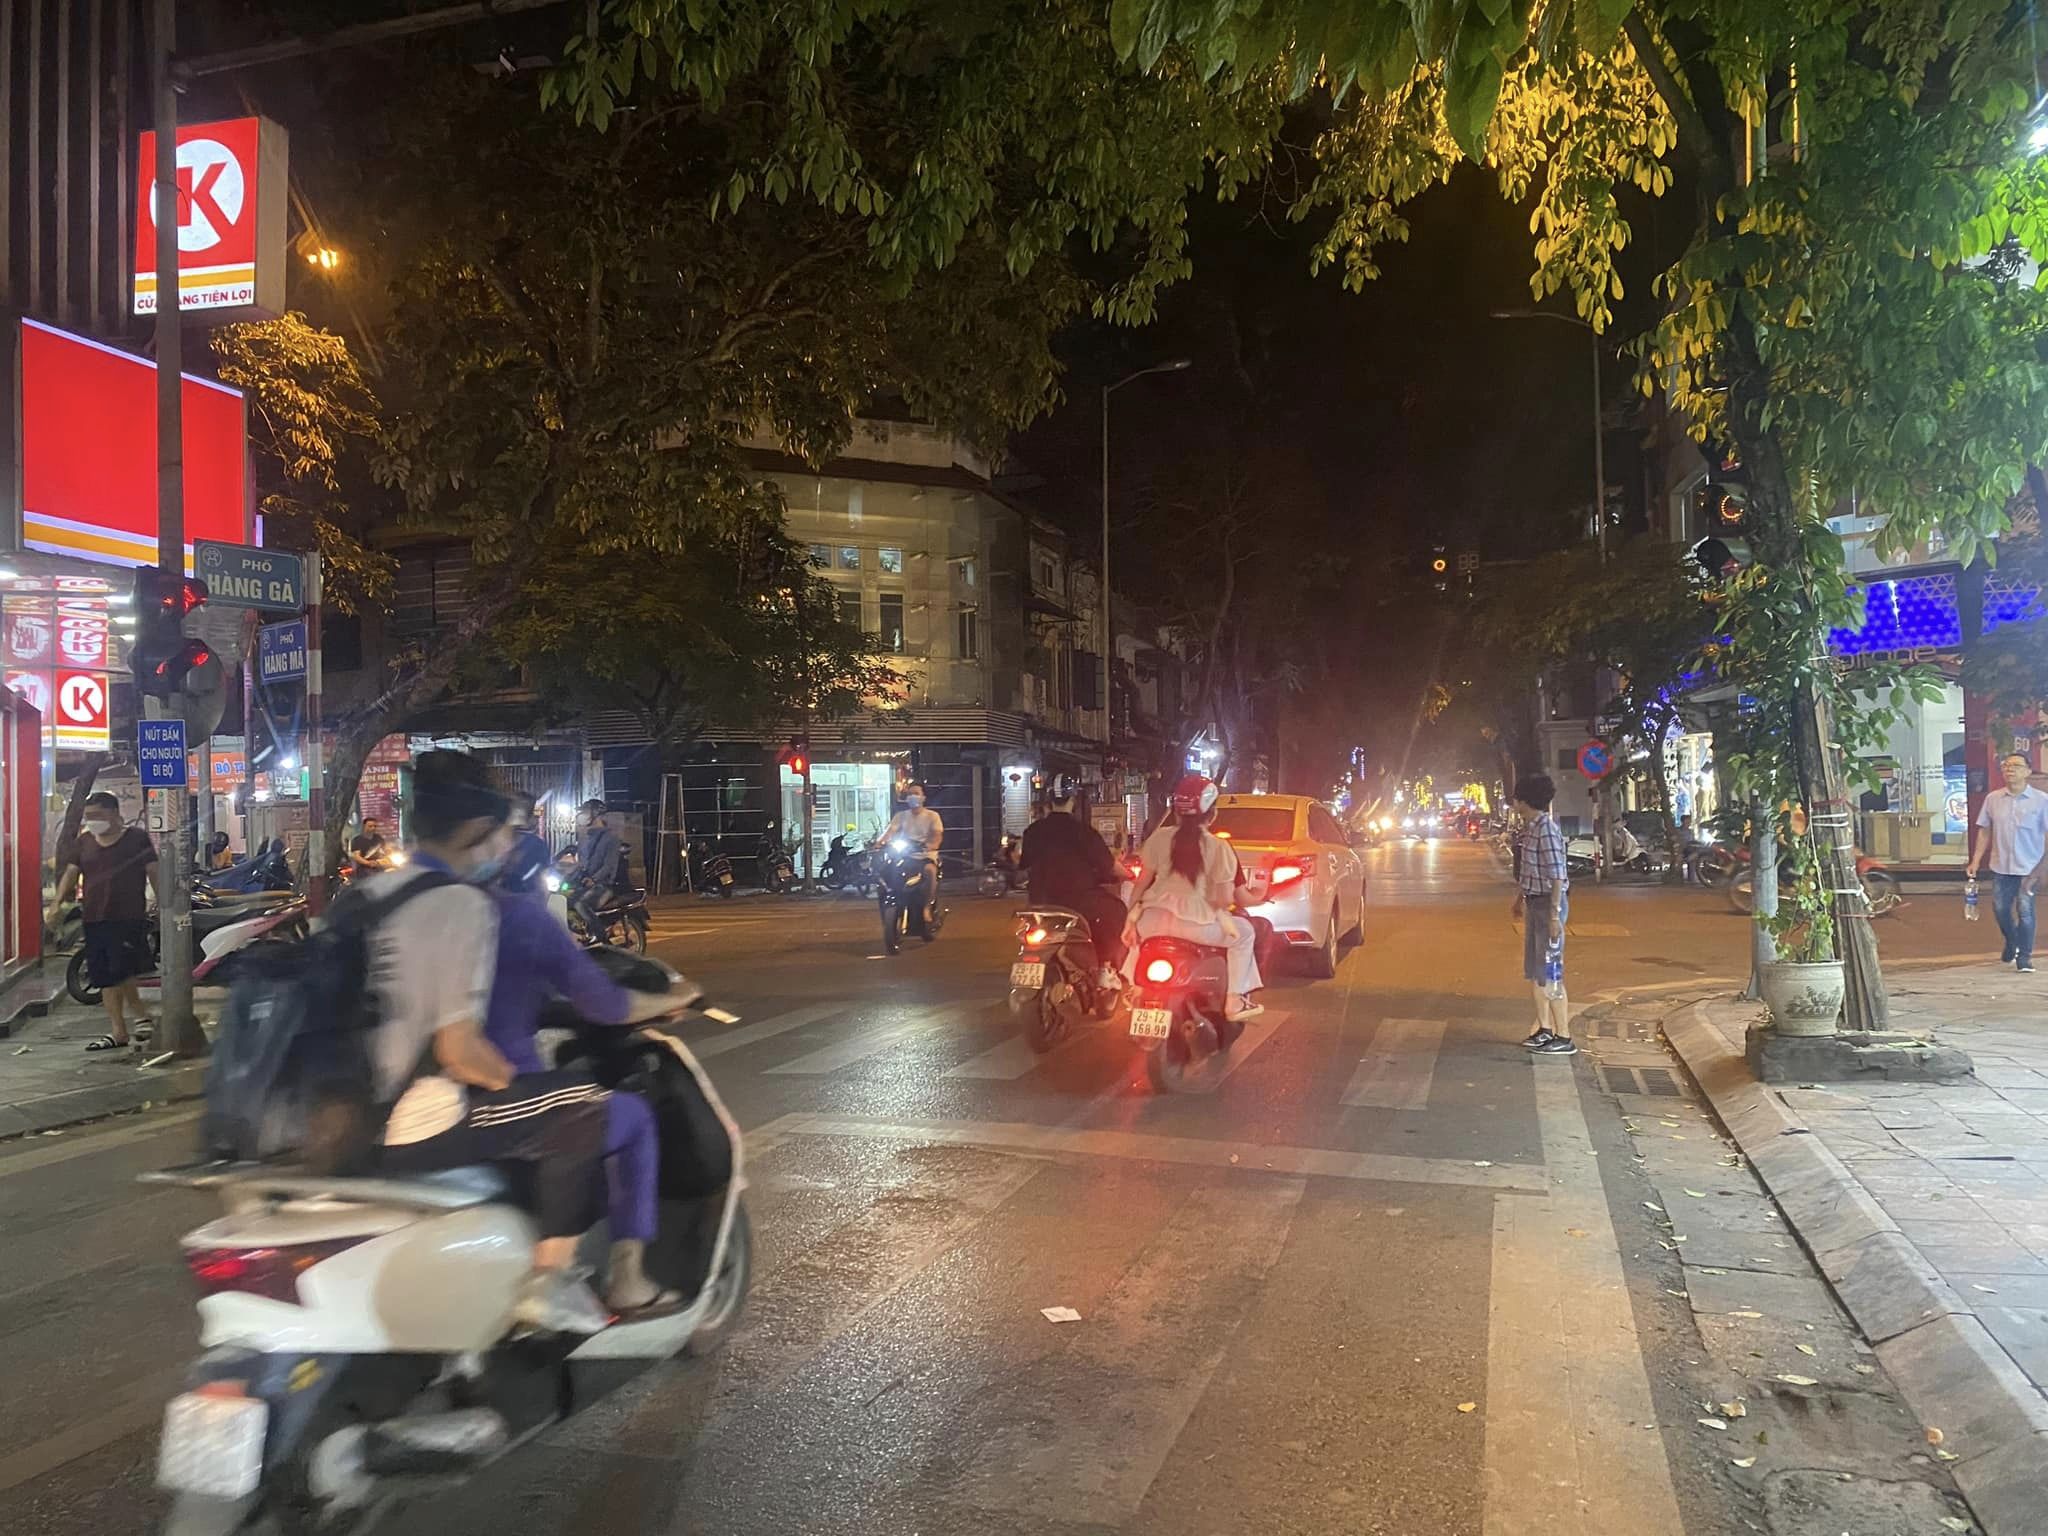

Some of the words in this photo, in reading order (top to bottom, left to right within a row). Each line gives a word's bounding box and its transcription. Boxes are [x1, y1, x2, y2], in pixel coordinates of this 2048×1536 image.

[137, 295, 158, 309] CỬ
[201, 290, 228, 305] TIỆN
[231, 288, 252, 303] LỢI
[241, 557, 273, 573] PHỐ
[207, 571, 263, 600] HÀNG
[268, 578, 295, 604] GÀ
[264, 650, 288, 675] HÀNG
[145, 725, 161, 741] NÚT
[162, 725, 180, 741] BẤM
[2014, 737, 2030, 752] 60
[141, 747, 158, 760] CHO
[152, 764, 161, 777] ĐI
[162, 762, 174, 779] BỘ
